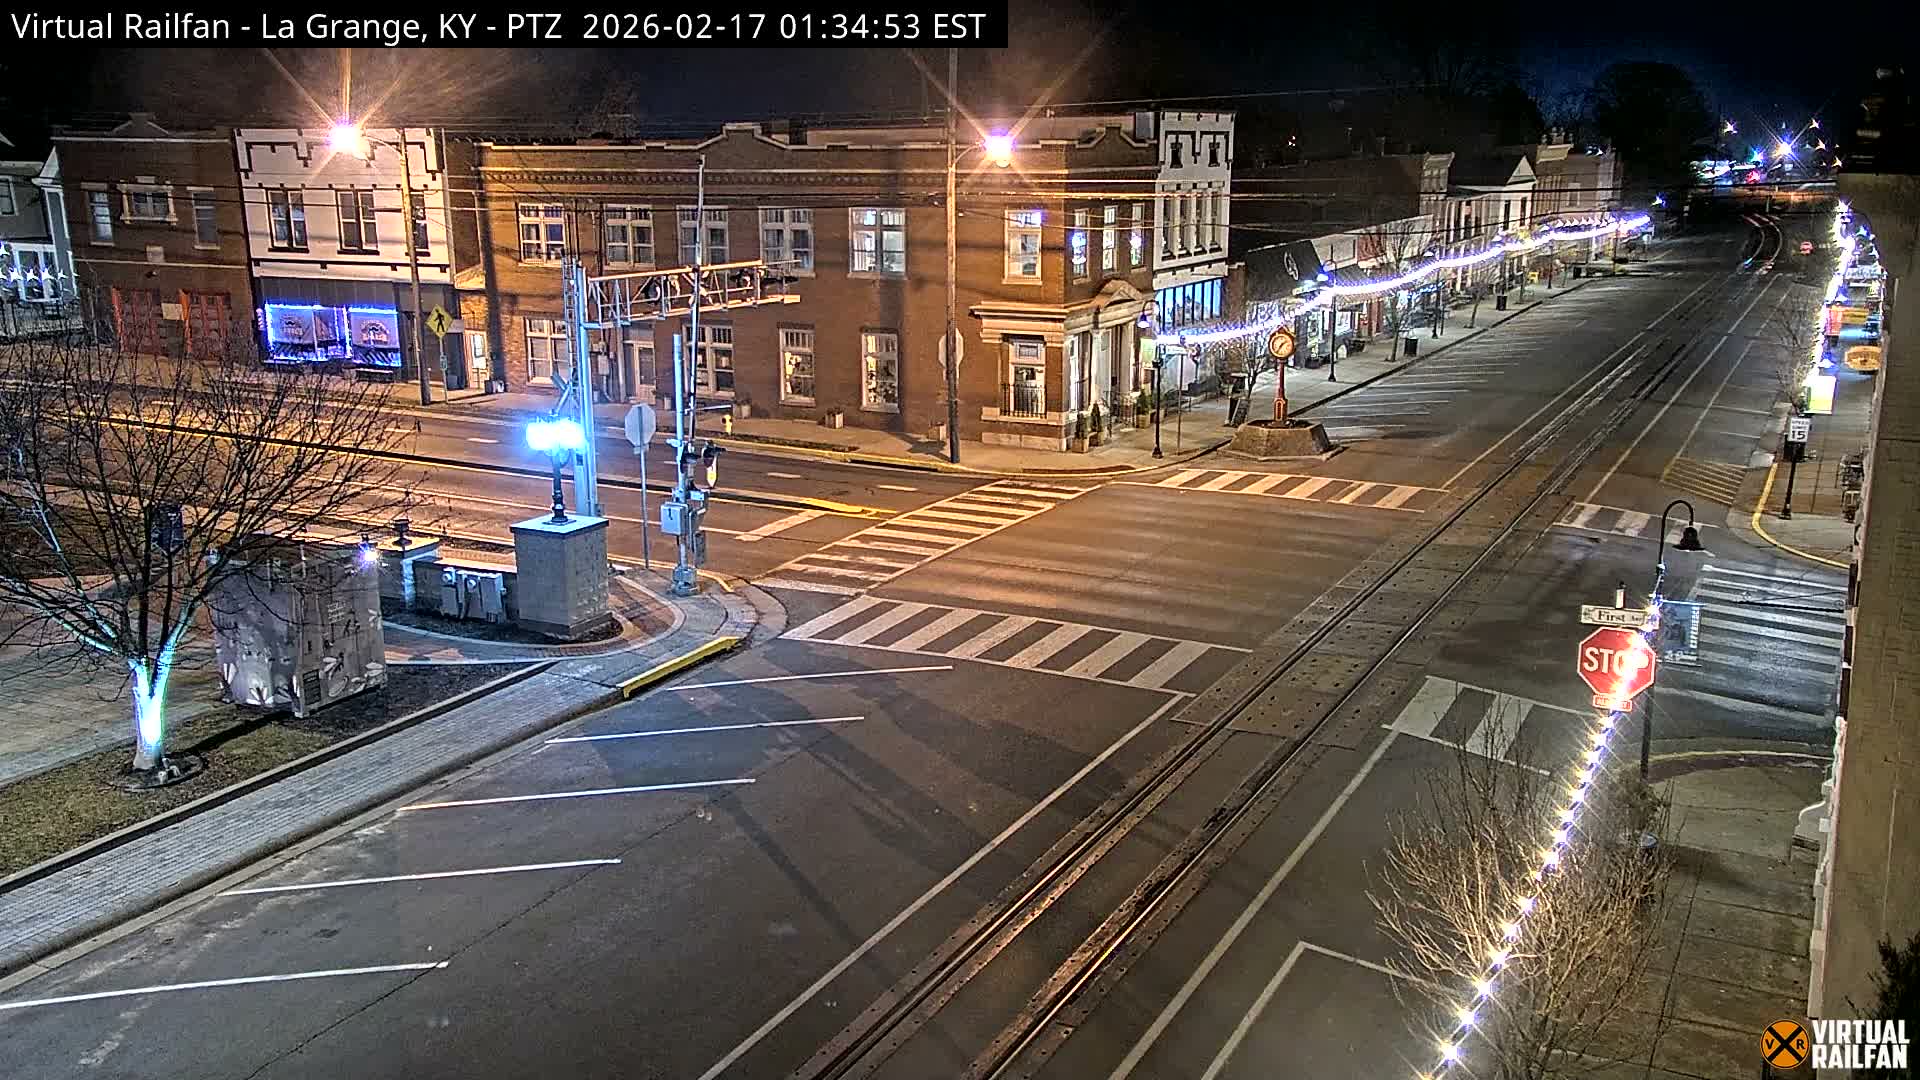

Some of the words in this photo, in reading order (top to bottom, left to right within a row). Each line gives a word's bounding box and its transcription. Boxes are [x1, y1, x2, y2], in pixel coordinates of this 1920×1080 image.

[1791, 430, 1806, 440] 15
[1598, 610, 1625, 622] First
[1583, 646, 1650, 678] STOP
